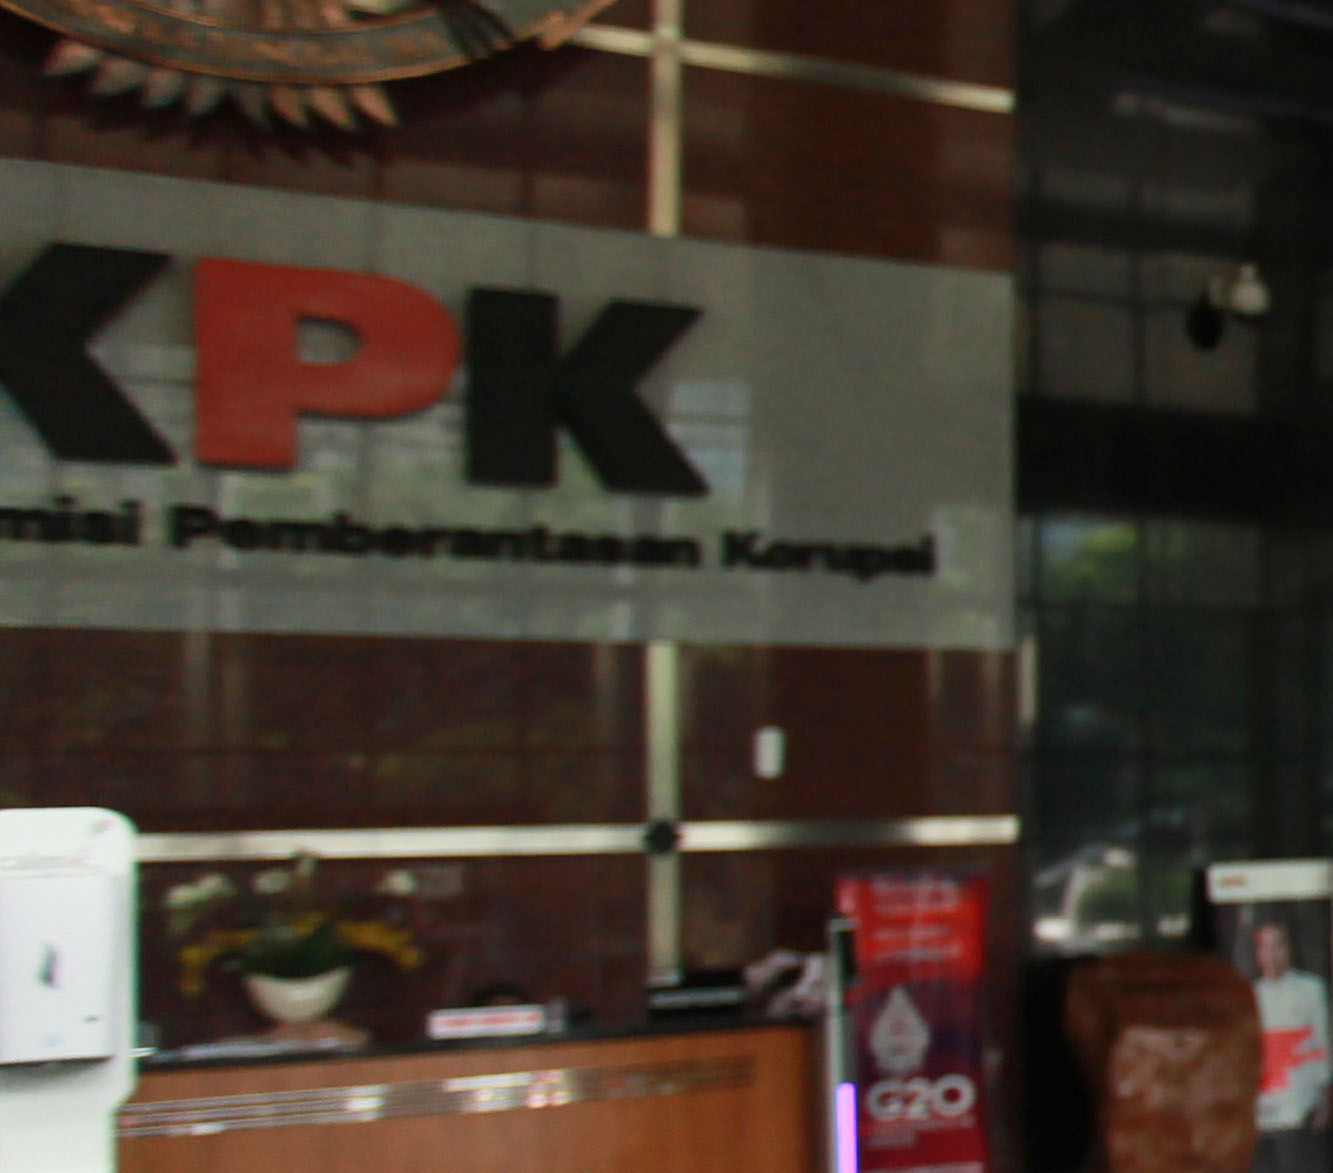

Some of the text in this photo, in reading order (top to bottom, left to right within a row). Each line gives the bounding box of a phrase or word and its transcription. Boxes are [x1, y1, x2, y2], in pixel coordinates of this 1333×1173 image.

[0, 241, 711, 497] KPK
[169, 504, 703, 568] Pemberantasan
[721, 529, 937, 583] Korupsi
[865, 1073, 977, 1122] G20
